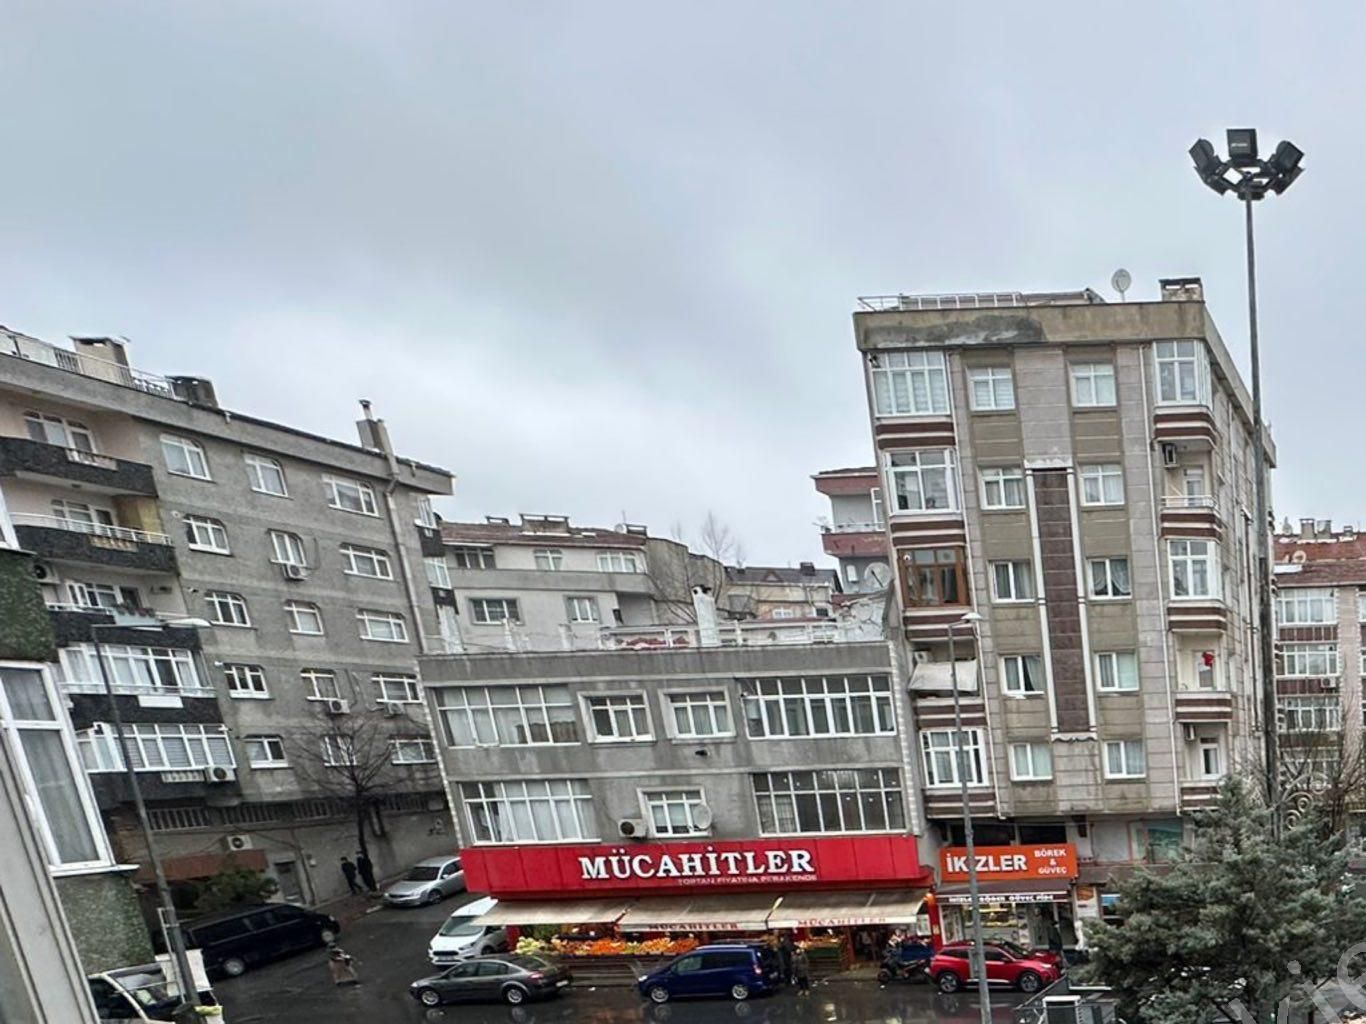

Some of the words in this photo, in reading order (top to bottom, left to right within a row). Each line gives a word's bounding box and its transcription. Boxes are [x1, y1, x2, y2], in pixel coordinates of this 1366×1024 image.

[1034, 848, 1068, 858] BÖREK
[578, 847, 814, 879] MÜCAHİTLER
[946, 853, 1028, 873] İKZLER
[1049, 858, 1058, 866] &
[1037, 866, 1068, 875] GÜVEÇ
